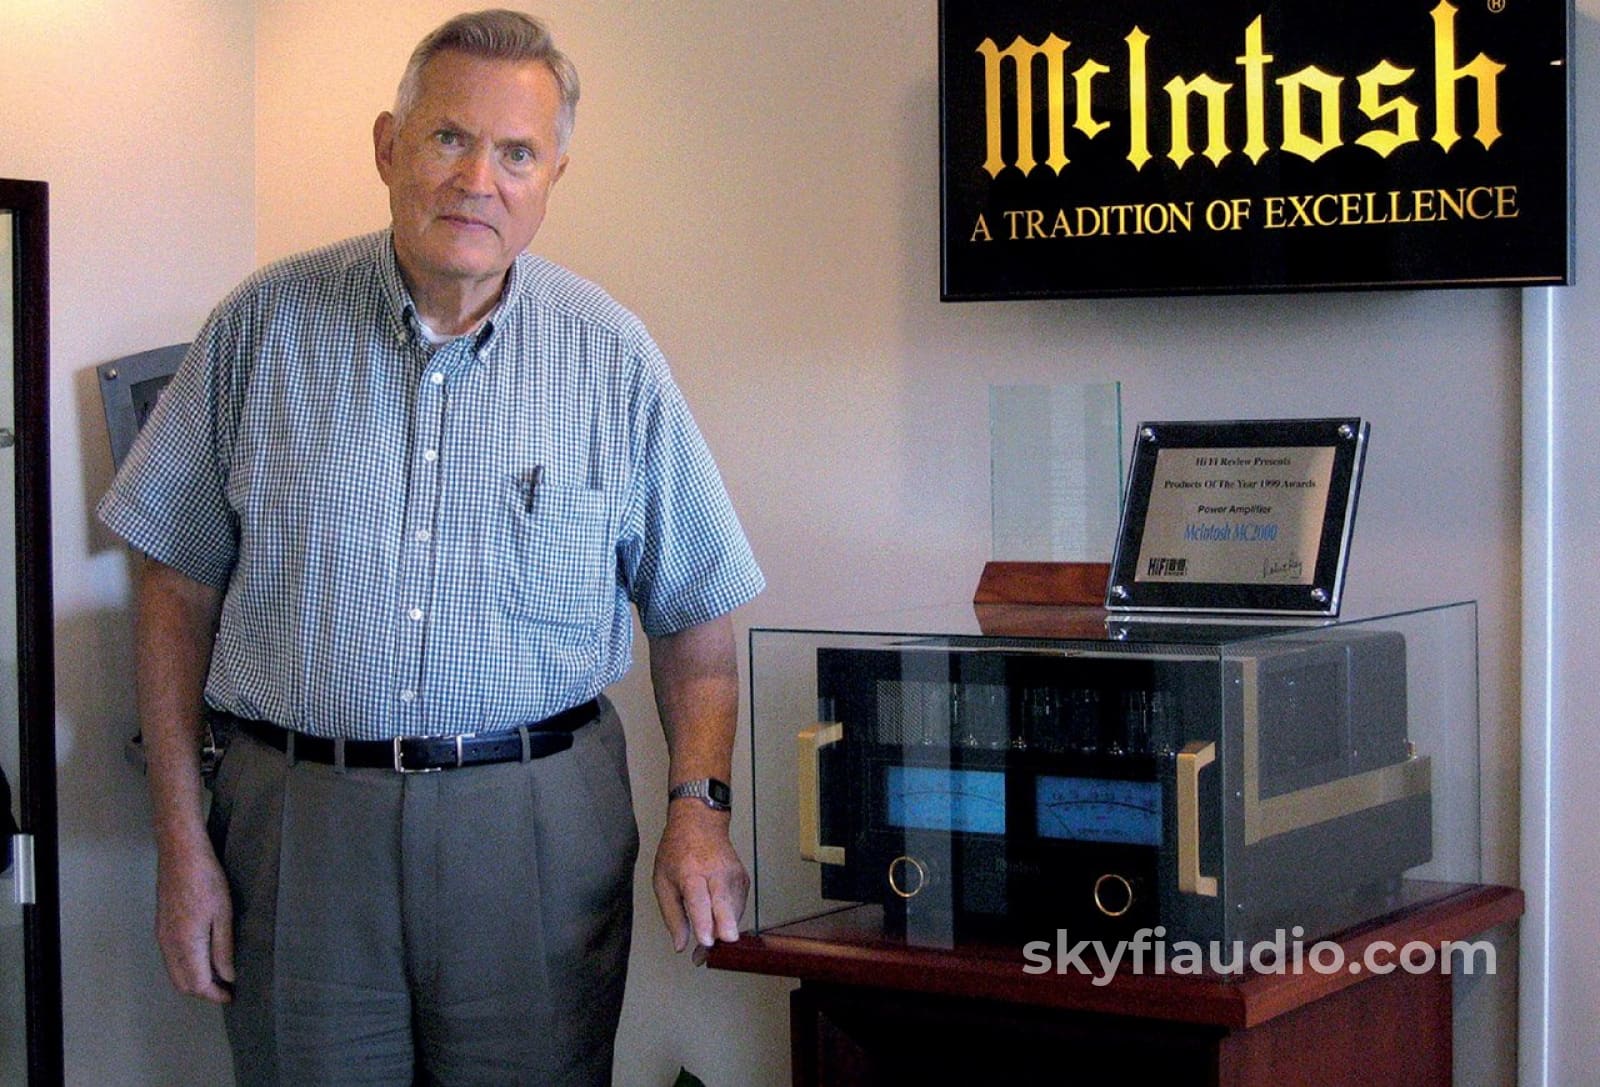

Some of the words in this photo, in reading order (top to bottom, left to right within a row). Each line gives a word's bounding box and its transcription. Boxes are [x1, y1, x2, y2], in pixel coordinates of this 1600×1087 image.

[970, 213, 993, 242] A
[1004, 201, 1194, 240] TRADITION
[1205, 198, 1252, 231] OF
[1263, 185, 1519, 229] EXCELLENCE
[1220, 457, 1251, 466] Review
[1253, 457, 1291, 466] Presents
[1164, 480, 1201, 489] Products
[1219, 480, 1235, 488] The
[1237, 480, 1258, 488] Year
[1281, 480, 1316, 488] Awards
[1197, 504, 1227, 513] Power
[1228, 504, 1272, 515] Amplifier
